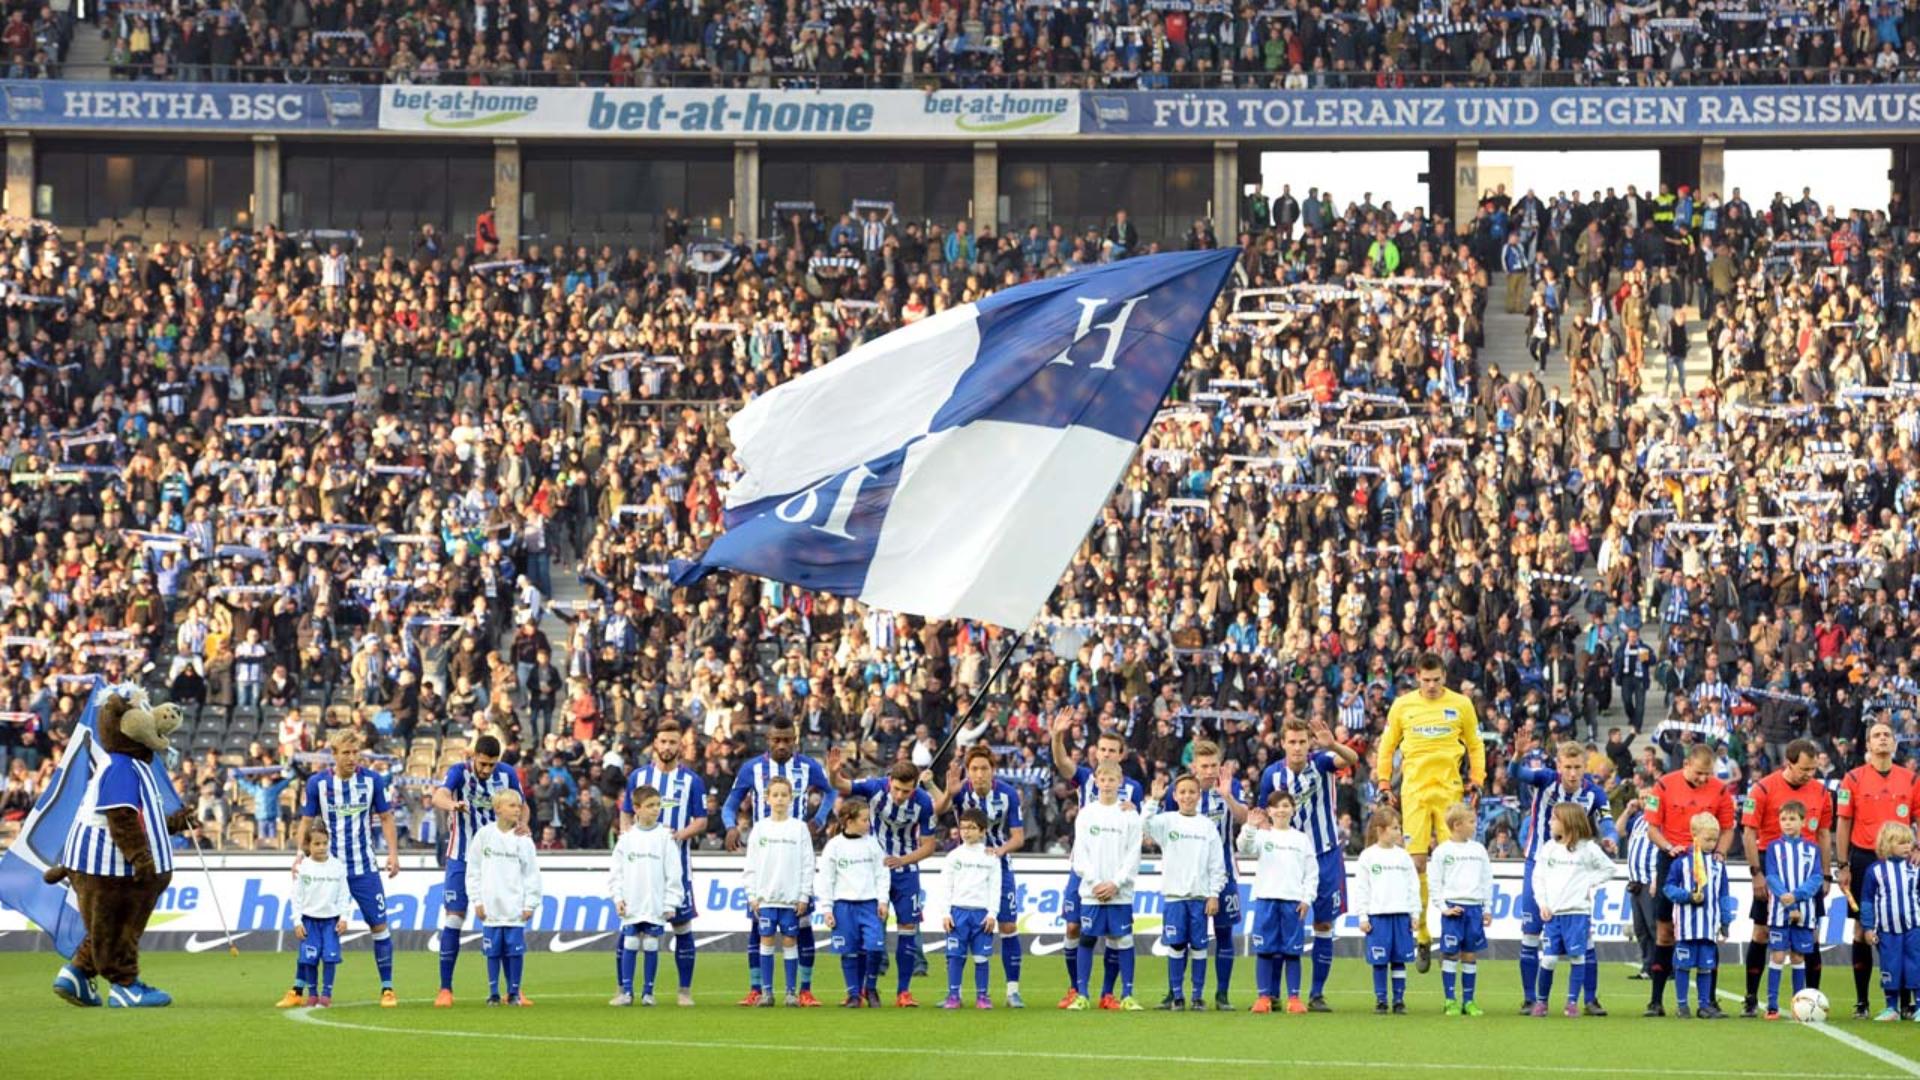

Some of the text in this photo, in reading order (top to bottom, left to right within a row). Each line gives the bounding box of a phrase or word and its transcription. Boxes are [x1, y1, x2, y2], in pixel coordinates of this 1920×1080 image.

[63, 91, 222, 120] HERTHA
[229, 93, 302, 121] BSC
[391, 88, 538, 112] bet-at-home
[587, 91, 874, 132] bet-at-home
[924, 94, 1068, 114] bet-at-home
[1153, 94, 1230, 128] FÜR
[1237, 98, 1445, 127] TOLERANZ
[1455, 97, 1540, 126] UND
[1550, 96, 1687, 125] GEGEN
[1459, 165, 1478, 187] N
[1045, 295, 1147, 370] H
[375, 893, 385, 911] 3
[1225, 894, 1240, 912] 20
